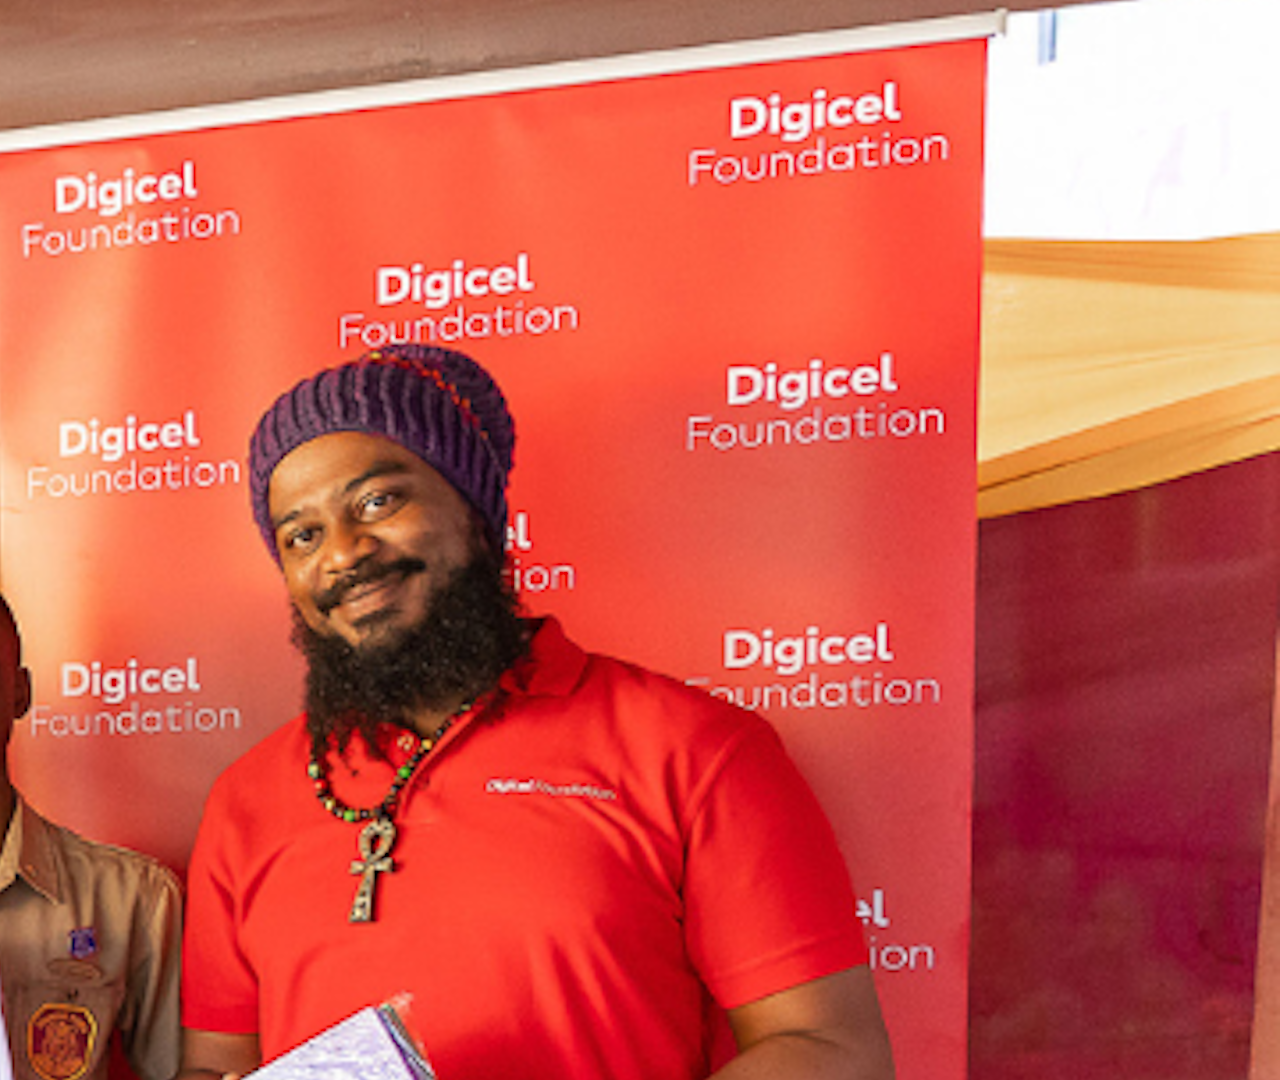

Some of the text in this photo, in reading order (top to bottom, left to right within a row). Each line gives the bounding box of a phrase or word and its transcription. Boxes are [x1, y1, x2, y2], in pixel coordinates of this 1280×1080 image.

[730, 81, 902, 141] Digicel
[687, 131, 949, 187] Foundation
[54, 160, 198, 214] Digicel
[21, 206, 240, 259] Foundation
[375, 252, 534, 309] Digicel
[338, 299, 578, 350] Foundation
[726, 352, 899, 410] Digicel
[58, 409, 201, 462] Digicel
[685, 402, 945, 453] Foundation
[25, 455, 240, 501] Foundation
[723, 622, 895, 676] Digicel
[60, 656, 201, 706] Digicel
[684, 671, 941, 711] undation
[30, 700, 241, 738] Foundation
